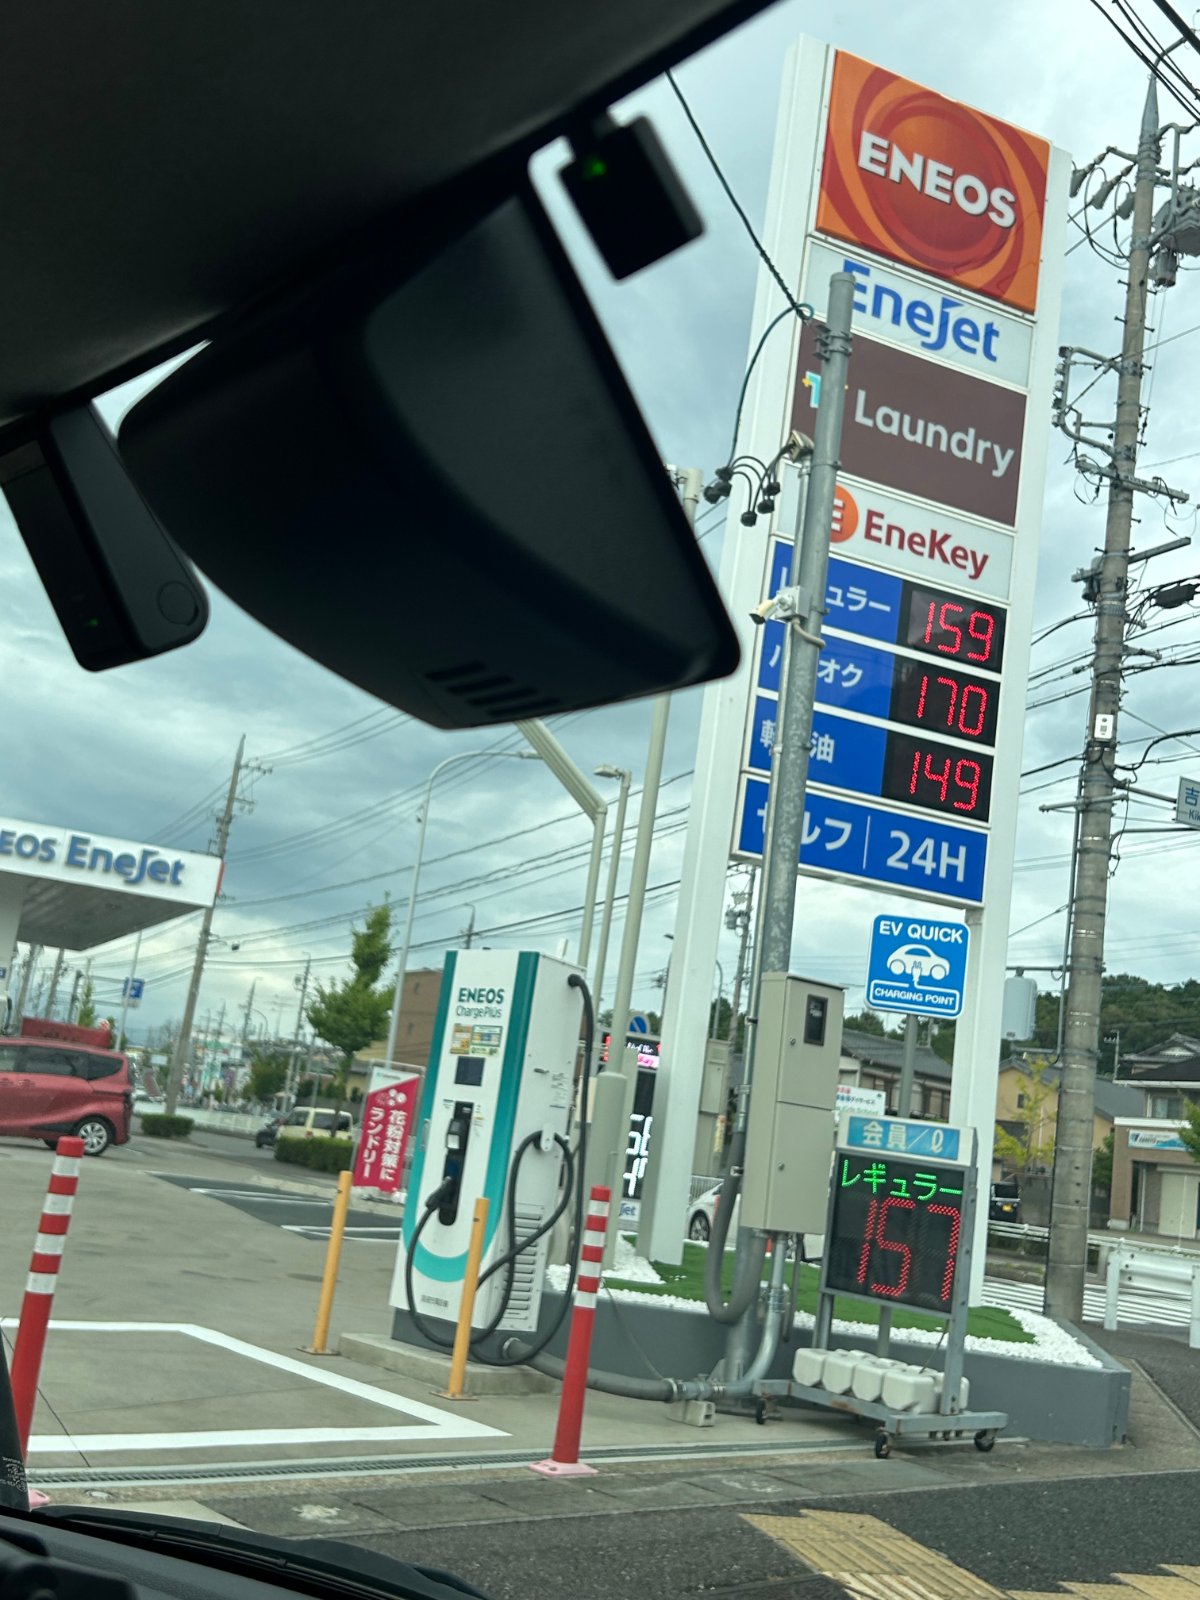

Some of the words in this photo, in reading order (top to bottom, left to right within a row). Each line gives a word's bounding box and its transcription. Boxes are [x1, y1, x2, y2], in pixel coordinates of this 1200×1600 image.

[858, 130, 1017, 229] ENEOS
[843, 259, 1000, 363] EneJet
[854, 388, 1015, 478] Laundry
[864, 508, 989, 580] EneKey
[778, 566, 891, 612] ュラー
[924, 601, 995, 662] 159
[917, 675, 988, 736] 170
[909, 751, 981, 811] 149
[64, 834, 185, 885] EneJet
[886, 829, 967, 883] 24H
[879, 920, 903, 937] EV
[907, 923, 963, 944] QUICK
[458, 987, 505, 1005] ENEOS
[874, 987, 923, 1002] CHARGING
[925, 993, 955, 1006] POINT
[842, 1159, 962, 1200] レギュラー
[856, 1197, 961, 1300] 157
